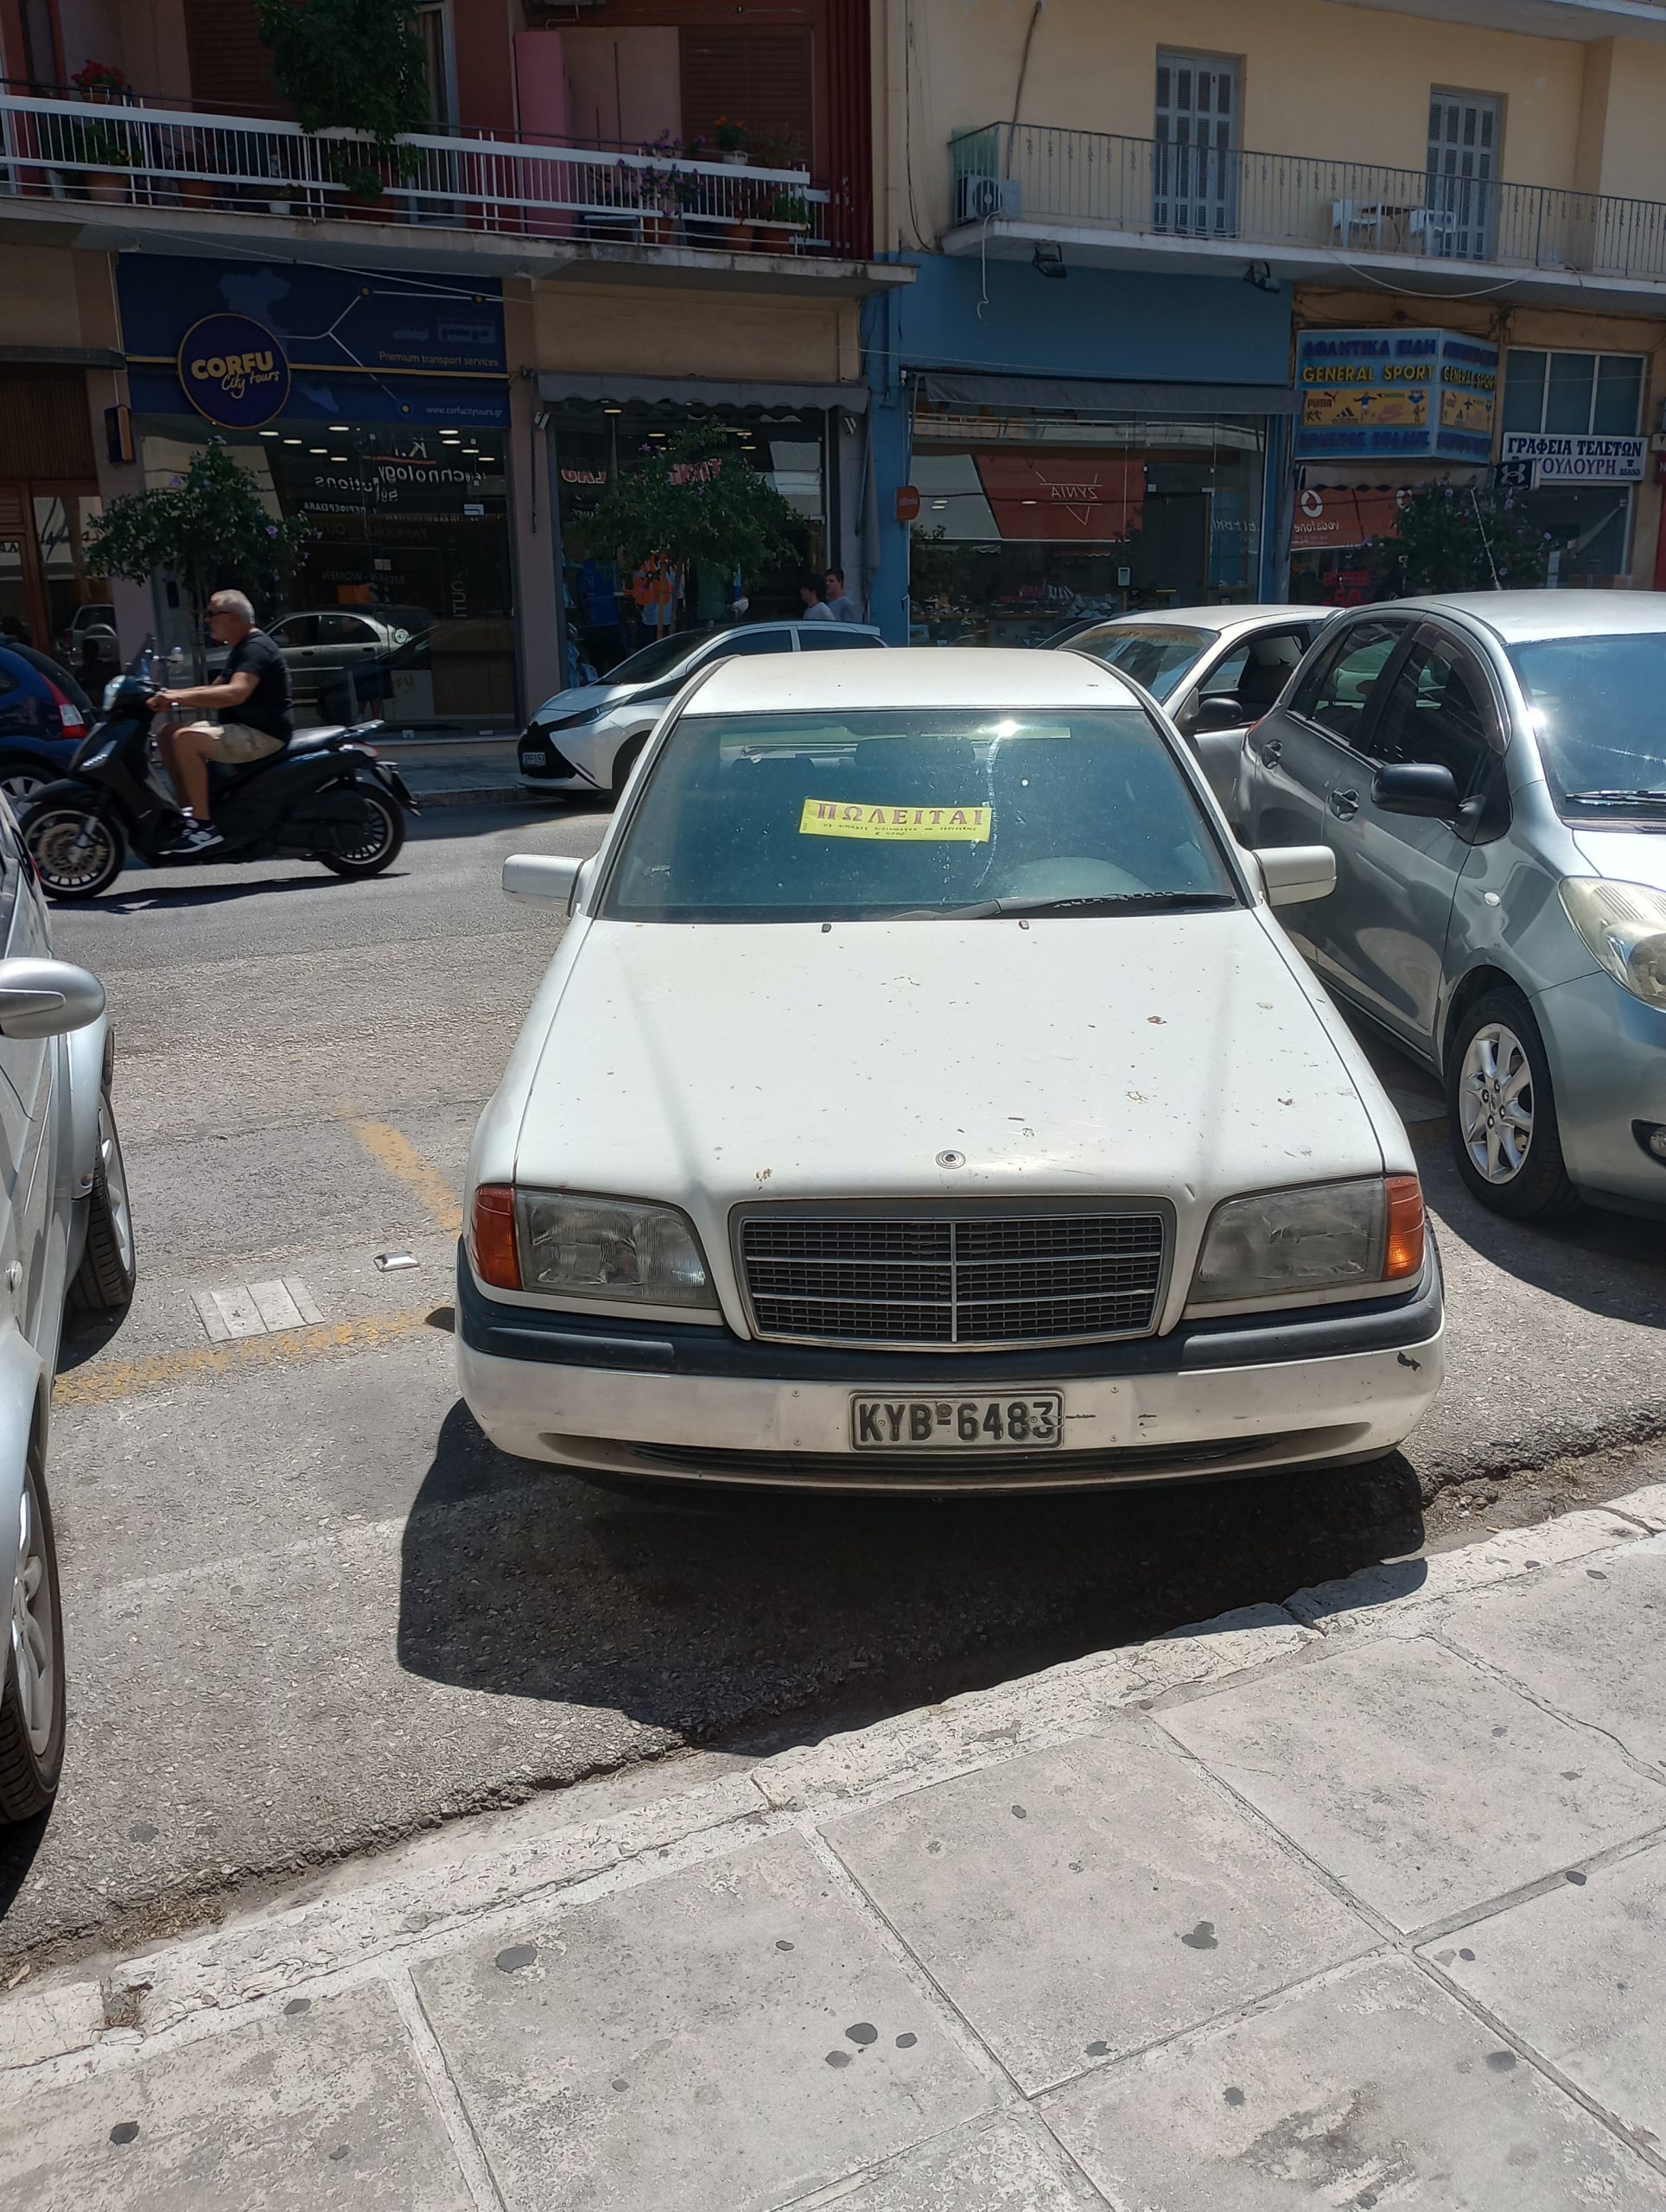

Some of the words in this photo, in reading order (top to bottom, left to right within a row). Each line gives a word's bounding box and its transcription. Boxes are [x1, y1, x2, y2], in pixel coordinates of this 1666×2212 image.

[190, 350, 274, 380] CORFU
[378, 351, 420, 363] Premium
[422, 354, 461, 366] transport
[463, 357, 499, 367] services
[221, 373, 246, 399] City
[250, 370, 281, 385] tours
[1302, 366, 1374, 383] GENERAL
[1384, 365, 1434, 382] SPORT
[1443, 365, 1474, 390] GENERAL
[424, 406, 503, 418] www.corfucitytours.gr
[1507, 437, 1572, 455] ΓΡΑΦΕΙΑ
[1577, 440, 1643, 457] ΤΕΛΕΤΩΝ
[1540, 458, 1617, 475] ΟΥΛΟΥΡΗ
[816, 802, 983, 826] ΠΩΛΕΙΤΑΙ
[859, 1401, 1054, 1442] KYB-6483
